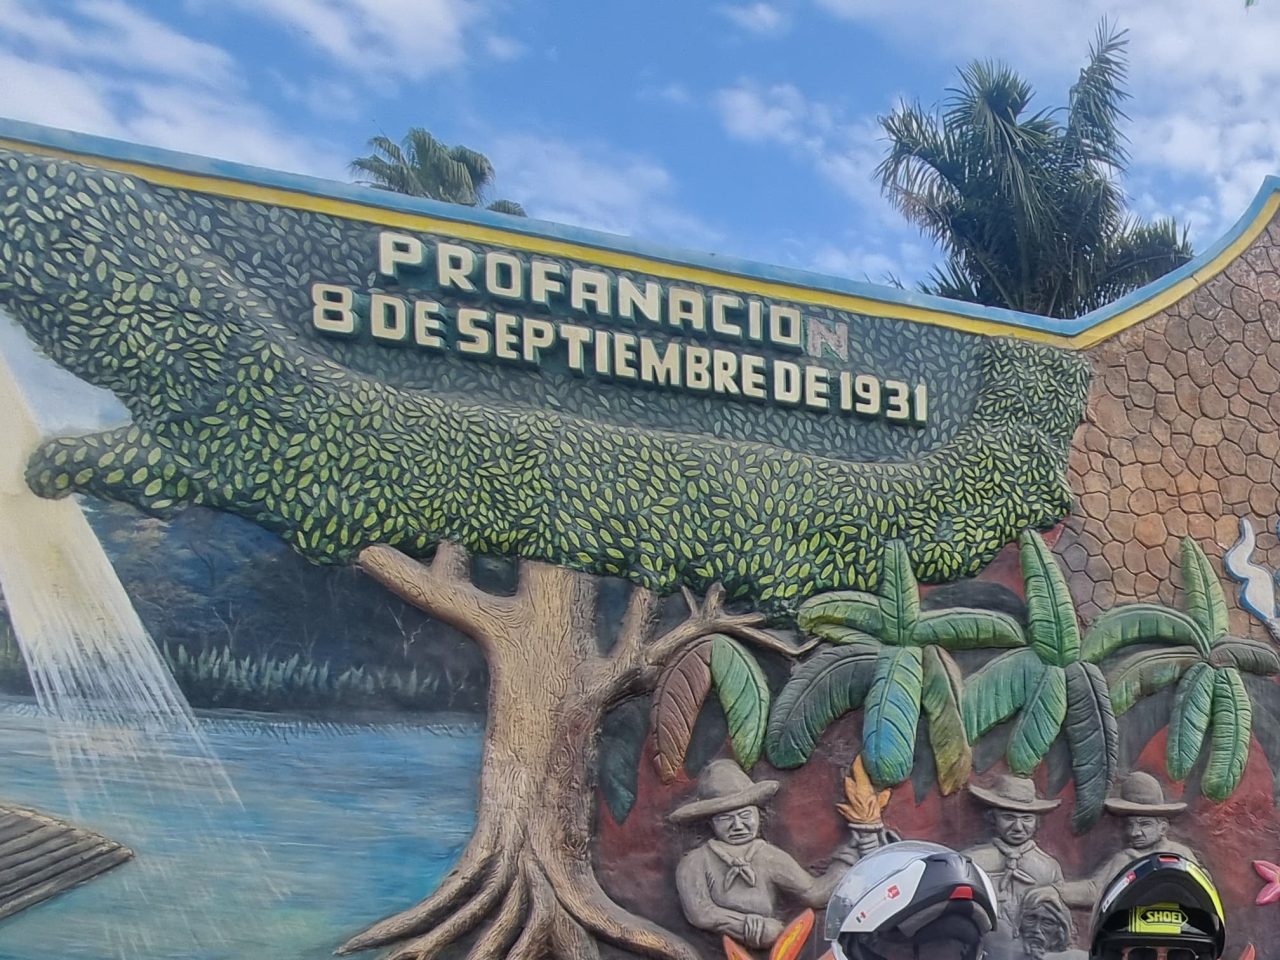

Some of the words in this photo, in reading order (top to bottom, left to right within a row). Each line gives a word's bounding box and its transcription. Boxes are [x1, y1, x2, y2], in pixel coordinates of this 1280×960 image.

[311, 283, 356, 334] 8
[369, 292, 443, 348] DE
[455, 307, 767, 401] SEPTIEMBRE
[772, 358, 831, 411] DE
[838, 369, 929, 423] 1931
[378, 231, 850, 361] PROFANACION
[1145, 910, 1183, 924] SHOEI
